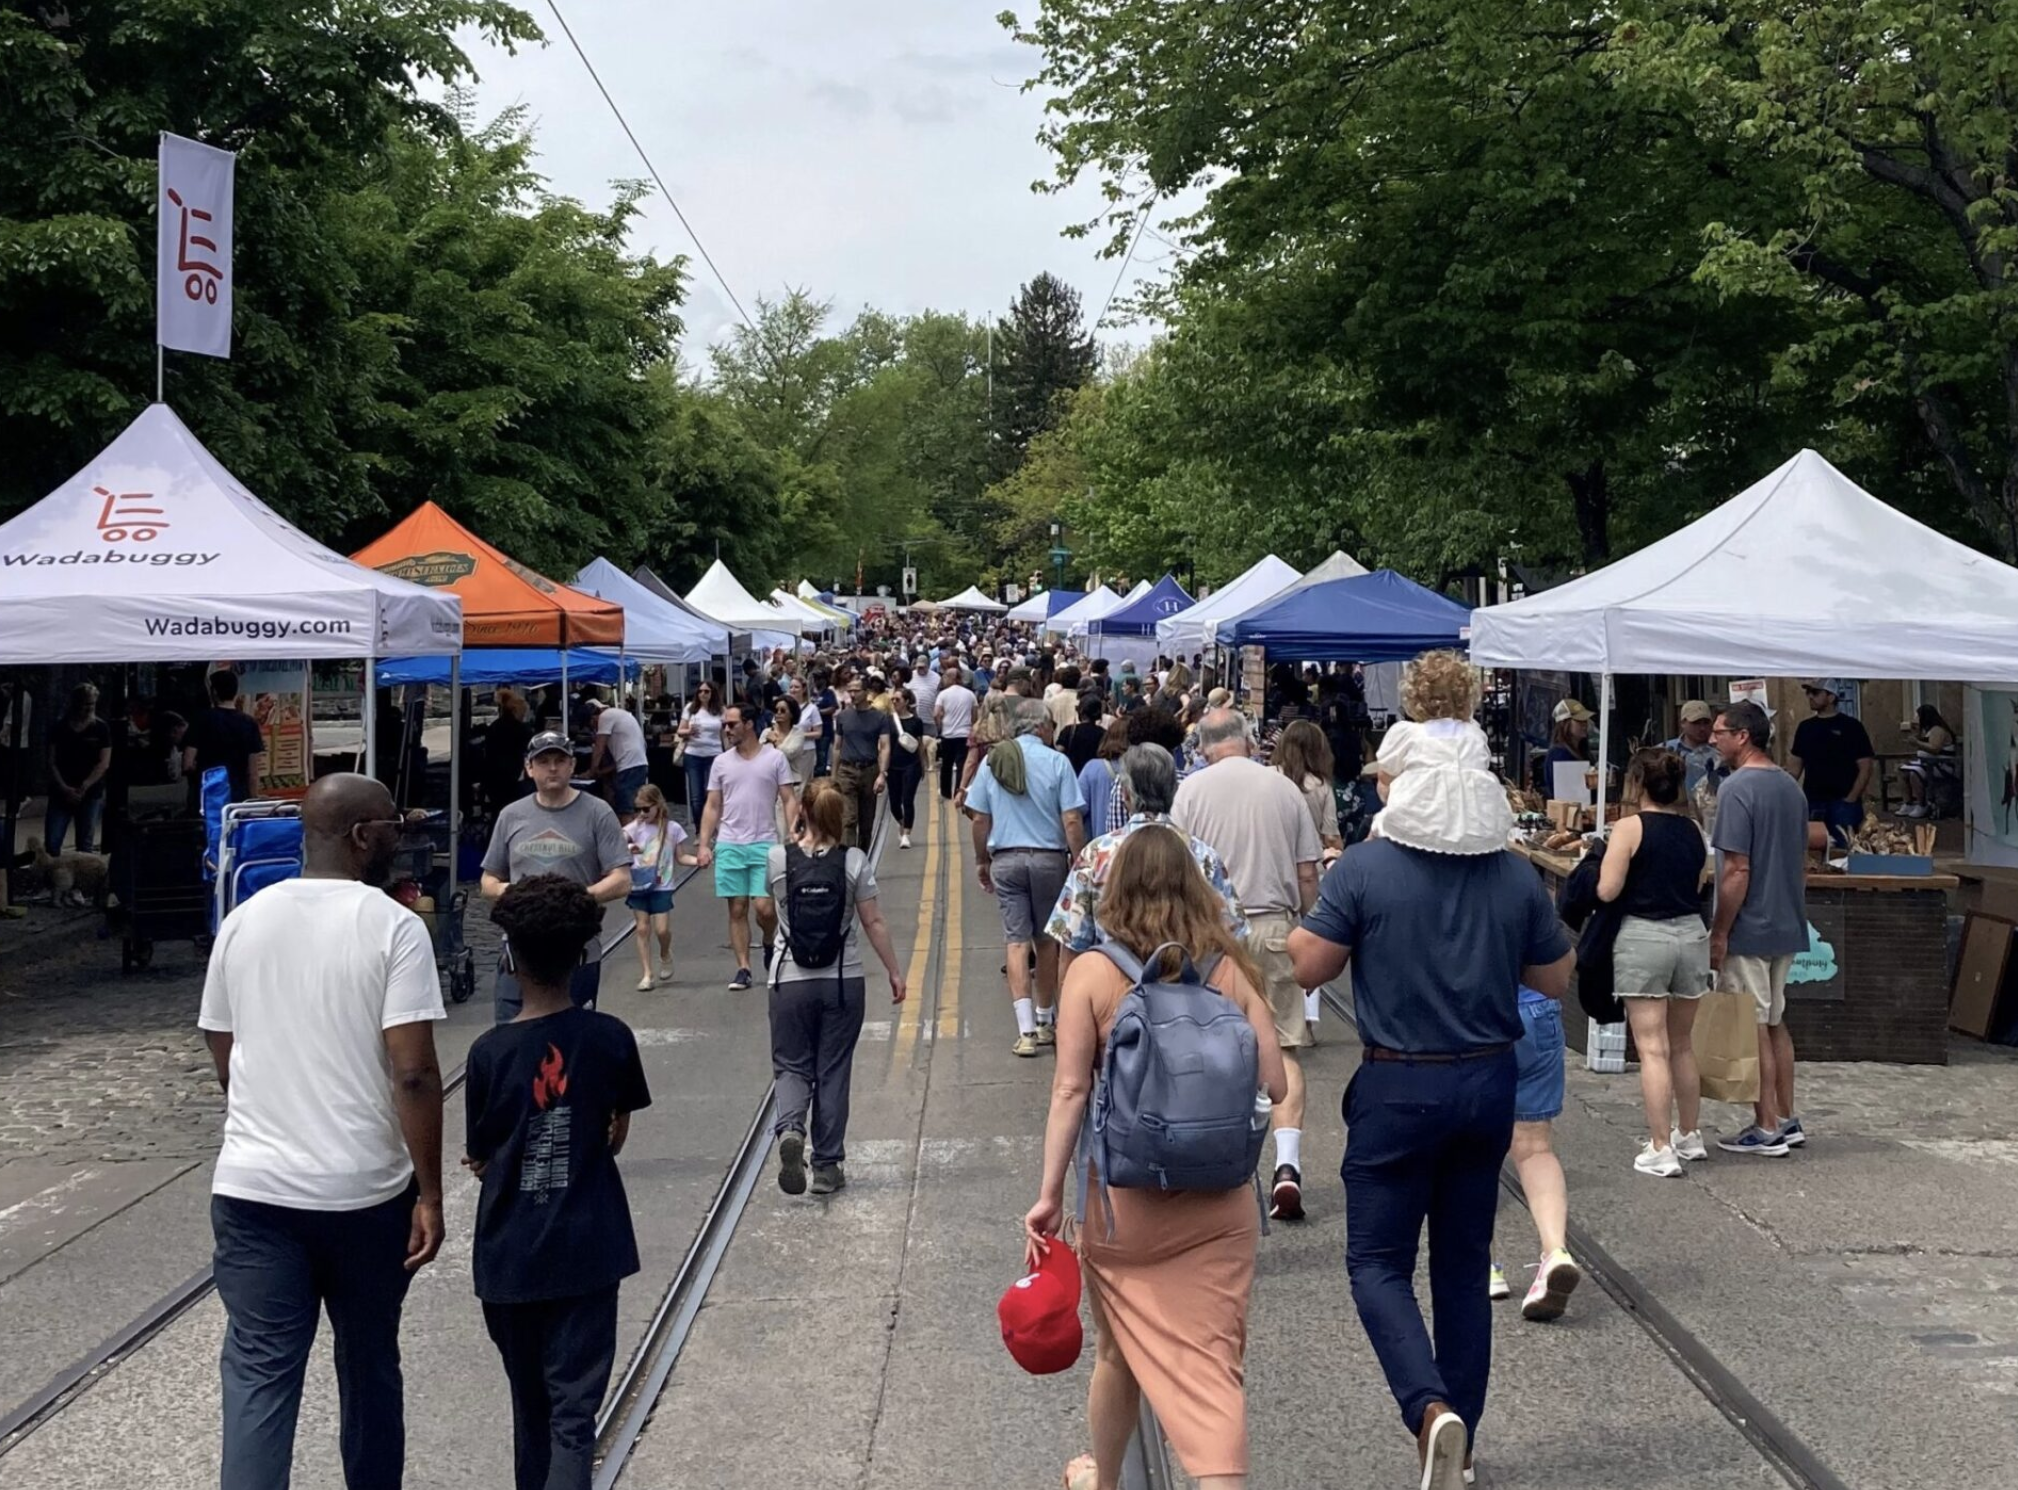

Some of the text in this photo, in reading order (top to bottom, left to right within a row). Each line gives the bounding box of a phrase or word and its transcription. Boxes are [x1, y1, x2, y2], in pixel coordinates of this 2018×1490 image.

[3, 550, 221, 567] Wadabuggy
[145, 616, 351, 638] Wadabuggy.com
[520, 843, 577, 853] CHESTNUT HILL
[536, 1141, 552, 1159] THE
[550, 1106, 572, 1188] BURN IT DOWN
[519, 1158, 536, 1191] IGNITE
[533, 1161, 550, 1190] STOKE
